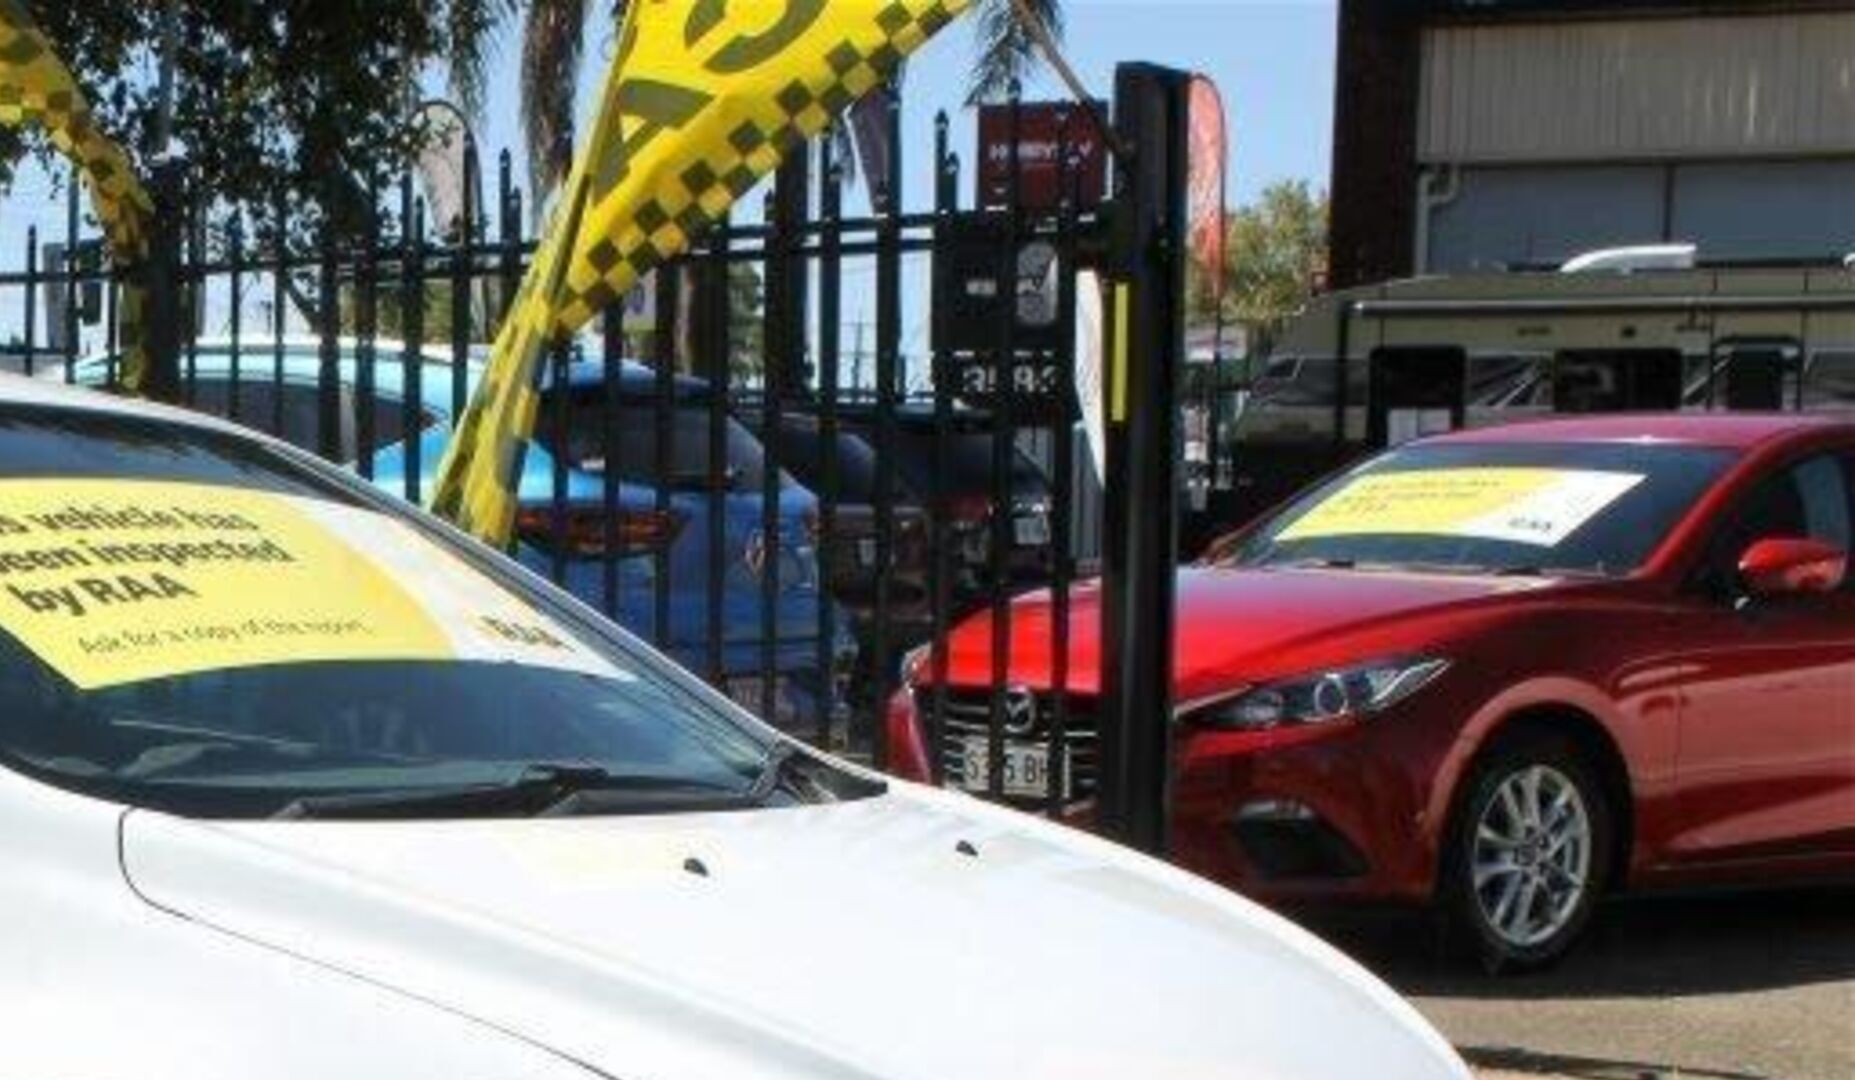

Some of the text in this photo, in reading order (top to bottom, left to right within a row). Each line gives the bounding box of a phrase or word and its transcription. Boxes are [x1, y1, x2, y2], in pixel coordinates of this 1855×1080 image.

[27, 505, 183, 534] vehicle
[175, 504, 262, 533] has
[74, 538, 298, 568] inspected
[6, 570, 202, 618] by RAA
